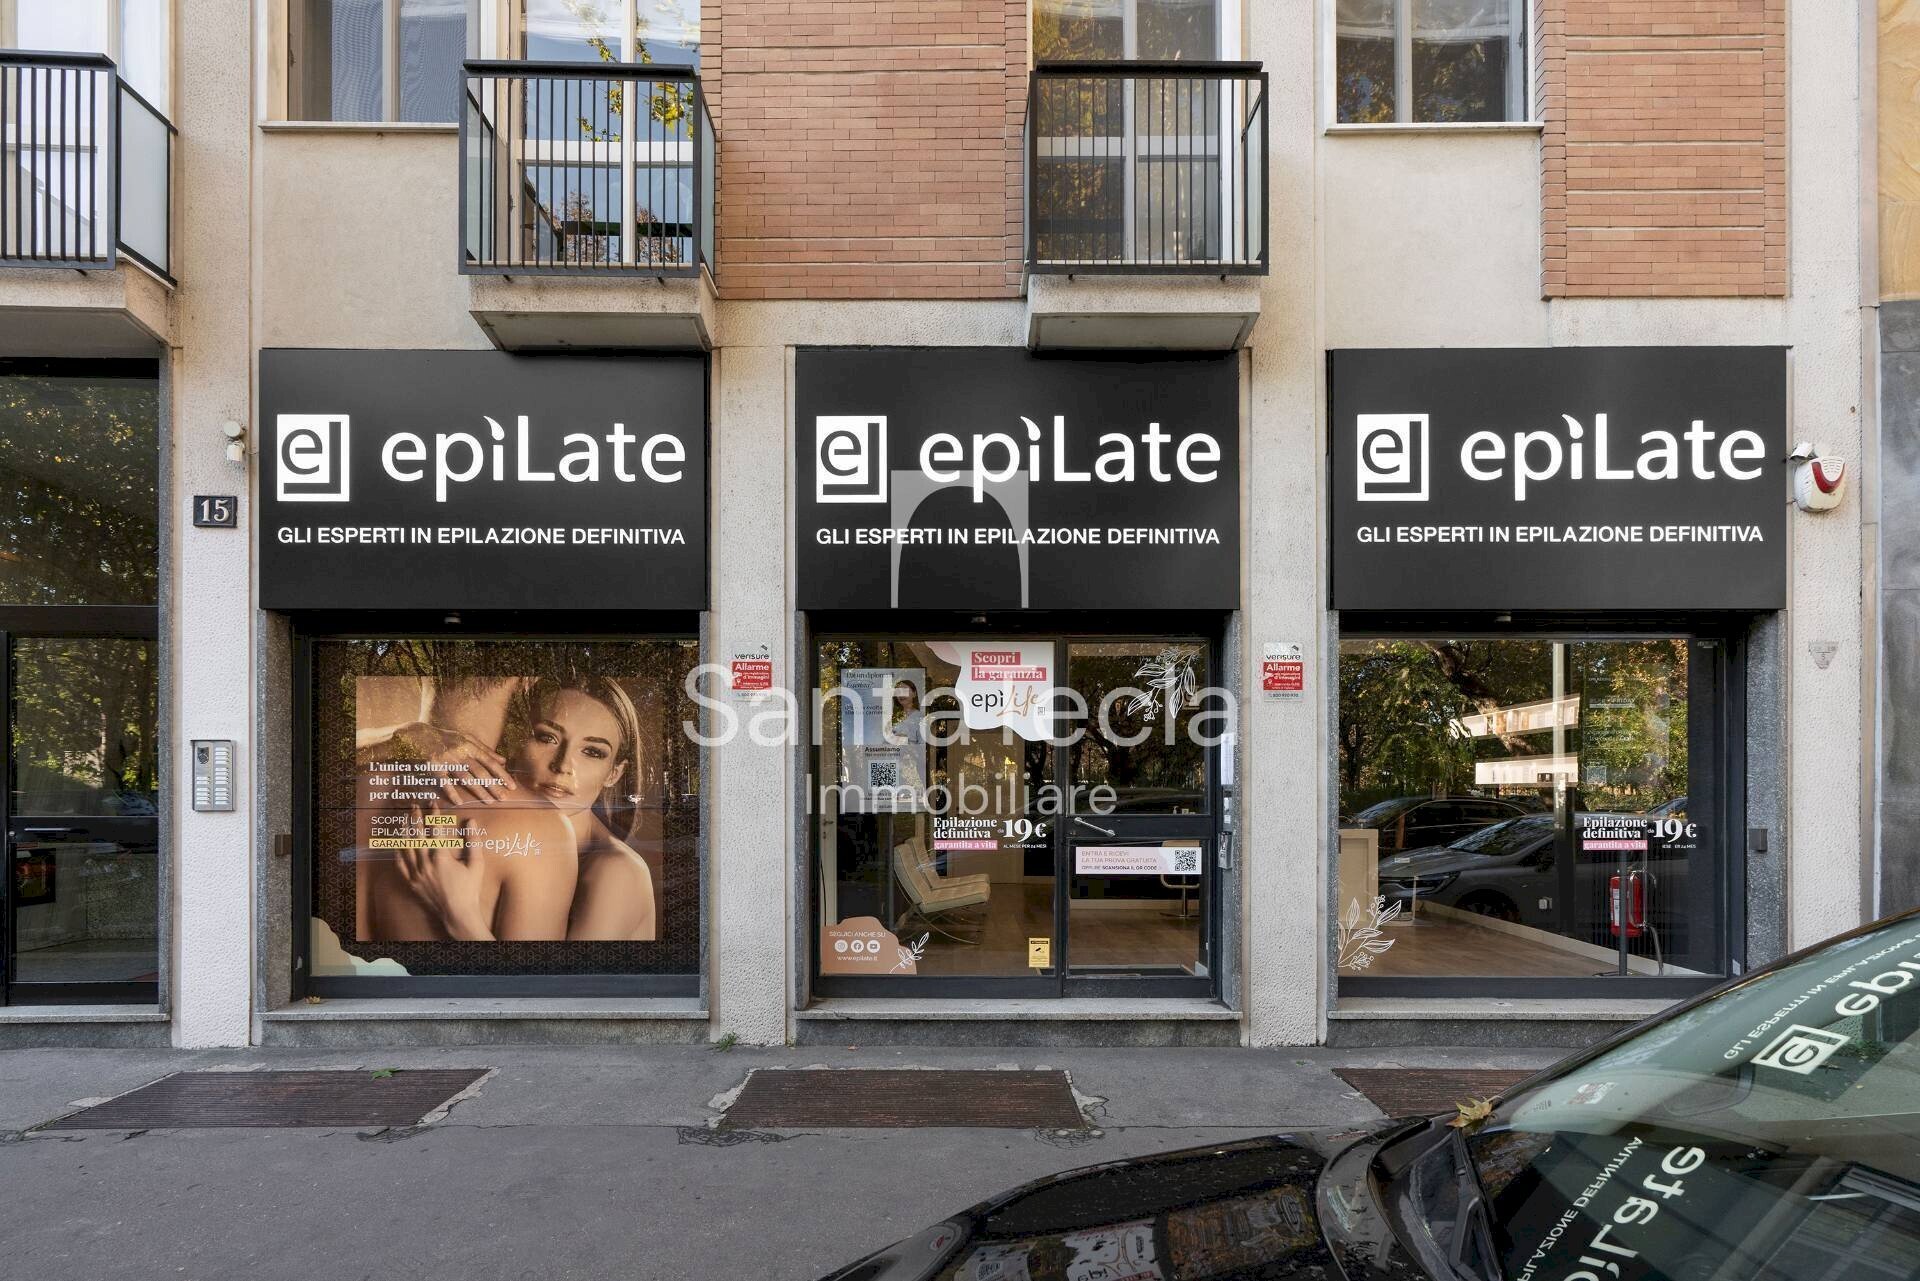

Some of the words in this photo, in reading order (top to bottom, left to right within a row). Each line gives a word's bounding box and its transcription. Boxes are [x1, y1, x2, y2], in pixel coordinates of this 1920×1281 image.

[200, 499, 230, 522] 15
[277, 528, 312, 544] GLI
[318, 528, 405, 544] ESPERTI
[411, 528, 432, 544] IN
[438, 528, 565, 544] EPILAZIONE
[572, 528, 686, 544] DEFINITIVA
[816, 528, 850, 544] GLI
[856, 528, 942, 544] ESPERTI
[948, 528, 968, 544] IN
[975, 528, 1101, 544] EPILAZIONE
[1107, 528, 1220, 544] DEFINITIVA
[1357, 526, 1390, 543] GLI
[1397, 526, 1483, 543] ESPERTI
[1490, 526, 1510, 543] IN
[1516, 526, 1643, 543] EPILAZIONE
[1650, 526, 1764, 543] DEFINITIVA
[974, 652, 1016, 665] Scopri
[974, 668, 986, 679] la
[988, 668, 1043, 681] garanzia
[414, 762, 468, 772] soluzione
[370, 776, 390, 786] che
[392, 776, 400, 786] ti
[404, 776, 437, 786] libera
[440, 778, 459, 787] per
[370, 792, 389, 801] per
[391, 790, 440, 800] davvero.
[410, 816, 423, 825] LA
[428, 816, 454, 825] VERA
[934, 817, 998, 829] Epilazione
[1583, 816, 1648, 828] Epilazione
[372, 828, 430, 836] EPILAZIONE
[432, 828, 487, 836] DEFINITIVA
[934, 828, 991, 838] definitiva
[1583, 828, 1640, 838] definitiva
[372, 840, 428, 848] GARANTITA
[430, 840, 437, 848] A
[440, 840, 462, 848] VITA
[934, 840, 972, 850] garantita
[980, 840, 996, 848] vita
[1584, 840, 1622, 850] garantita
[1630, 840, 1646, 848] vita
